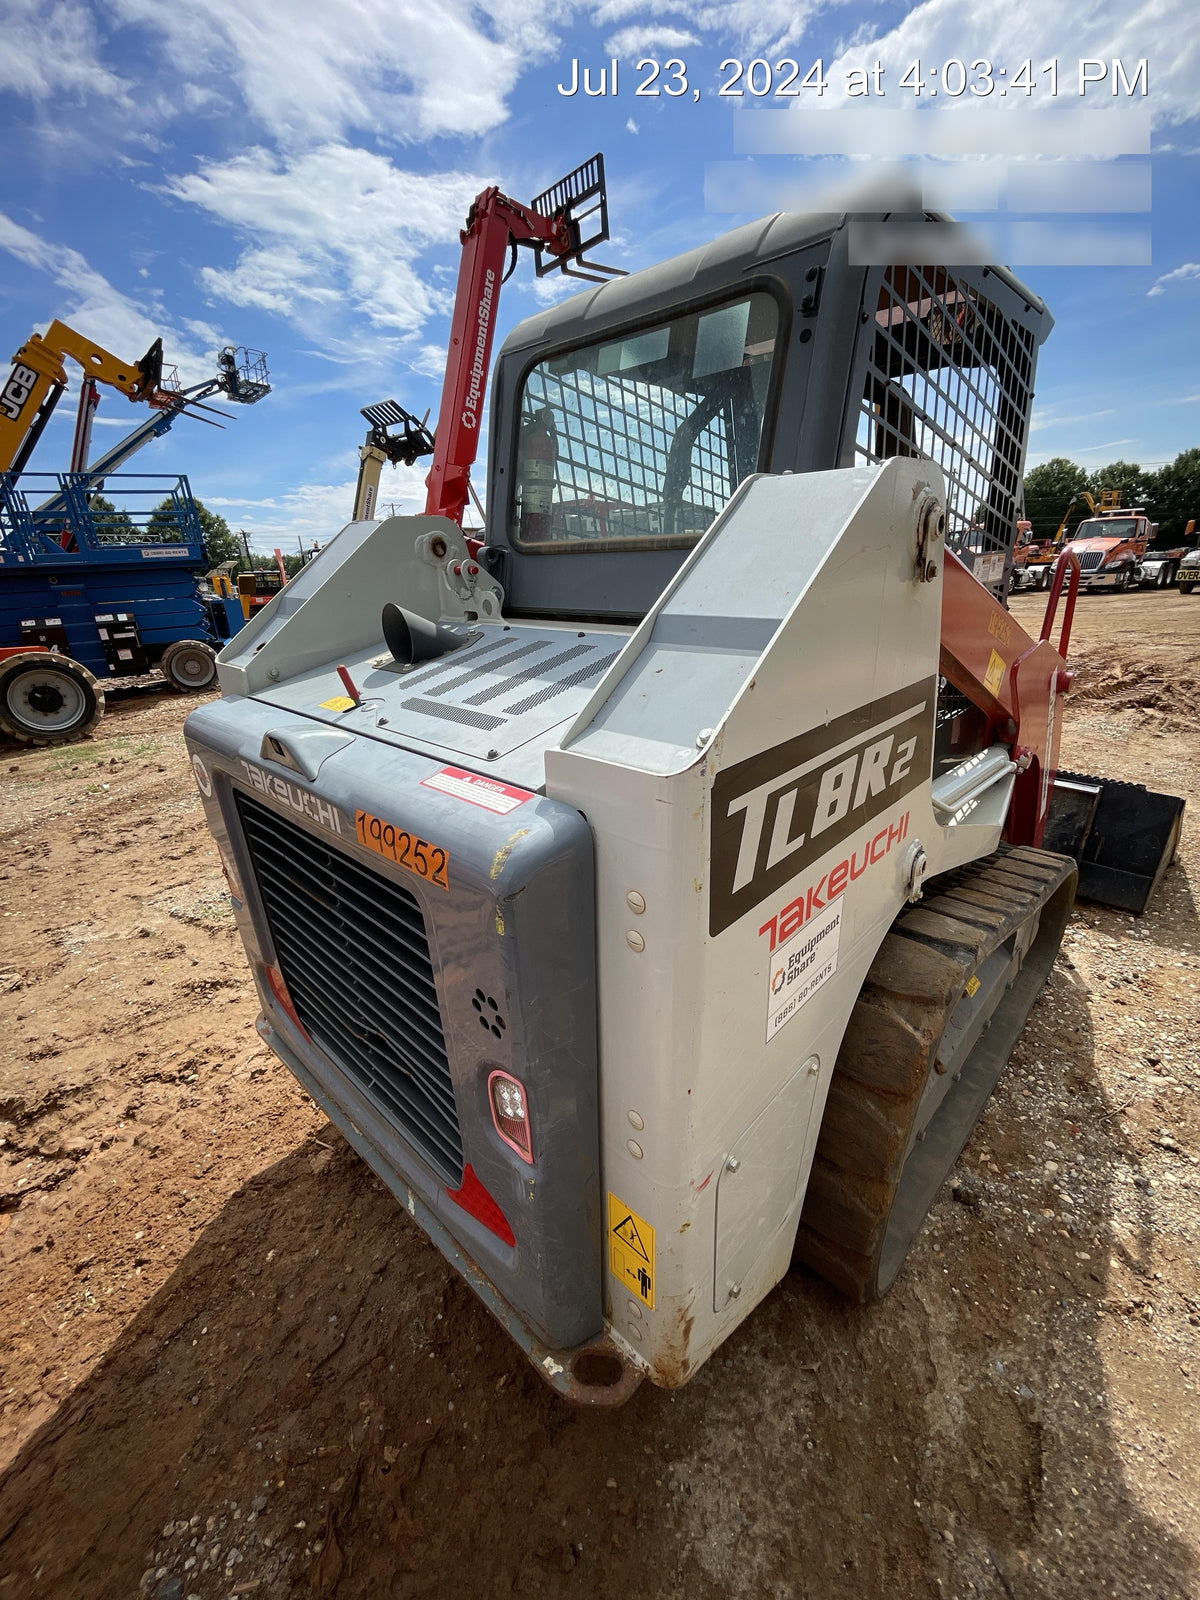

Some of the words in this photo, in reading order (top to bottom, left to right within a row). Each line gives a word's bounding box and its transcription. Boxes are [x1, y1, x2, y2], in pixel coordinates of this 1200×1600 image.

[466, 268, 495, 411] EquipmentShare
[1, 365, 37, 419] JCB
[1177, 571, 1200, 580] OVER
[472, 780, 506, 793] DANGER
[727, 734, 918, 894] TL8R2
[358, 812, 447, 887] 199252
[786, 951, 817, 986] Share
[787, 914, 841, 971] Equipment
